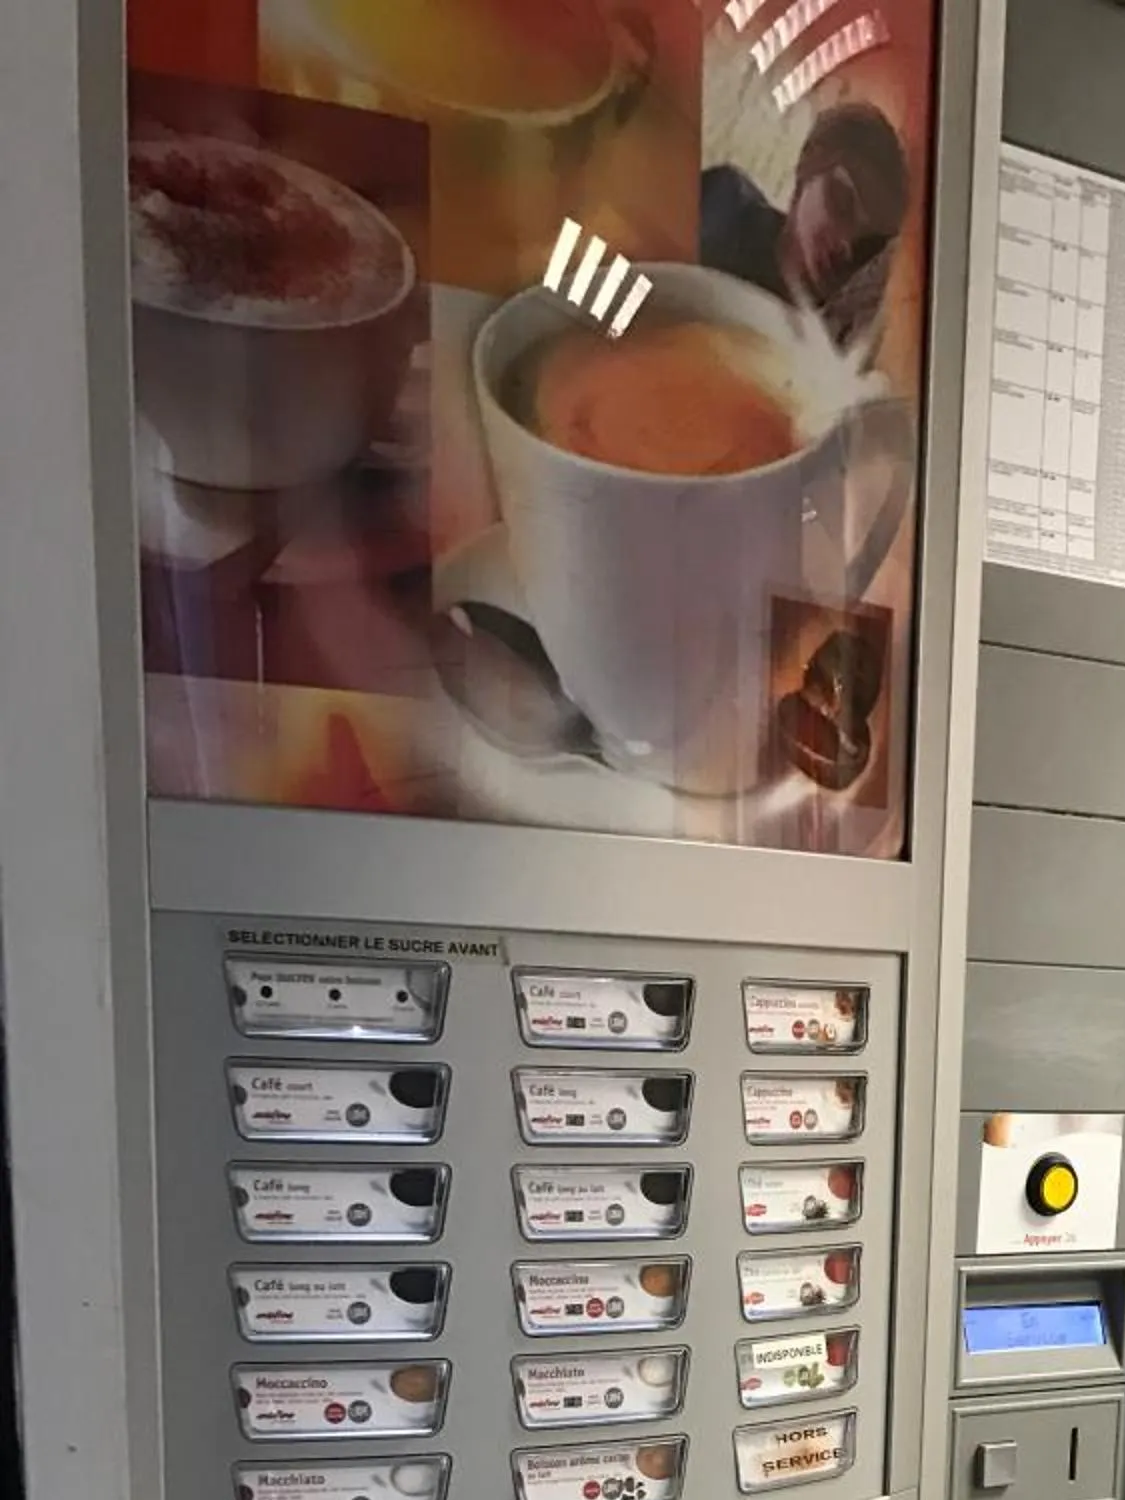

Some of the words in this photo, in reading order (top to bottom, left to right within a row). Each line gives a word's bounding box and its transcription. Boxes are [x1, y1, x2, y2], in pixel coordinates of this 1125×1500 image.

[364, 938, 384, 950] LE
[388, 939, 444, 954] SUCRE
[447, 942, 499, 956] AVANT
[529, 985, 555, 998] Café
[251, 1078, 283, 1092] Café
[529, 1084, 555, 1097] Café
[253, 1179, 284, 1192] Café
[528, 1180, 553, 1194] Café
[254, 1280, 285, 1292] Café
[756, 1344, 823, 1364] INDISPONIBLE
[256, 1377, 328, 1390] Moccaccino
[775, 1427, 828, 1443] HORS
[762, 1447, 846, 1472] SERVICE
[258, 1474, 325, 1487] Macchiato
